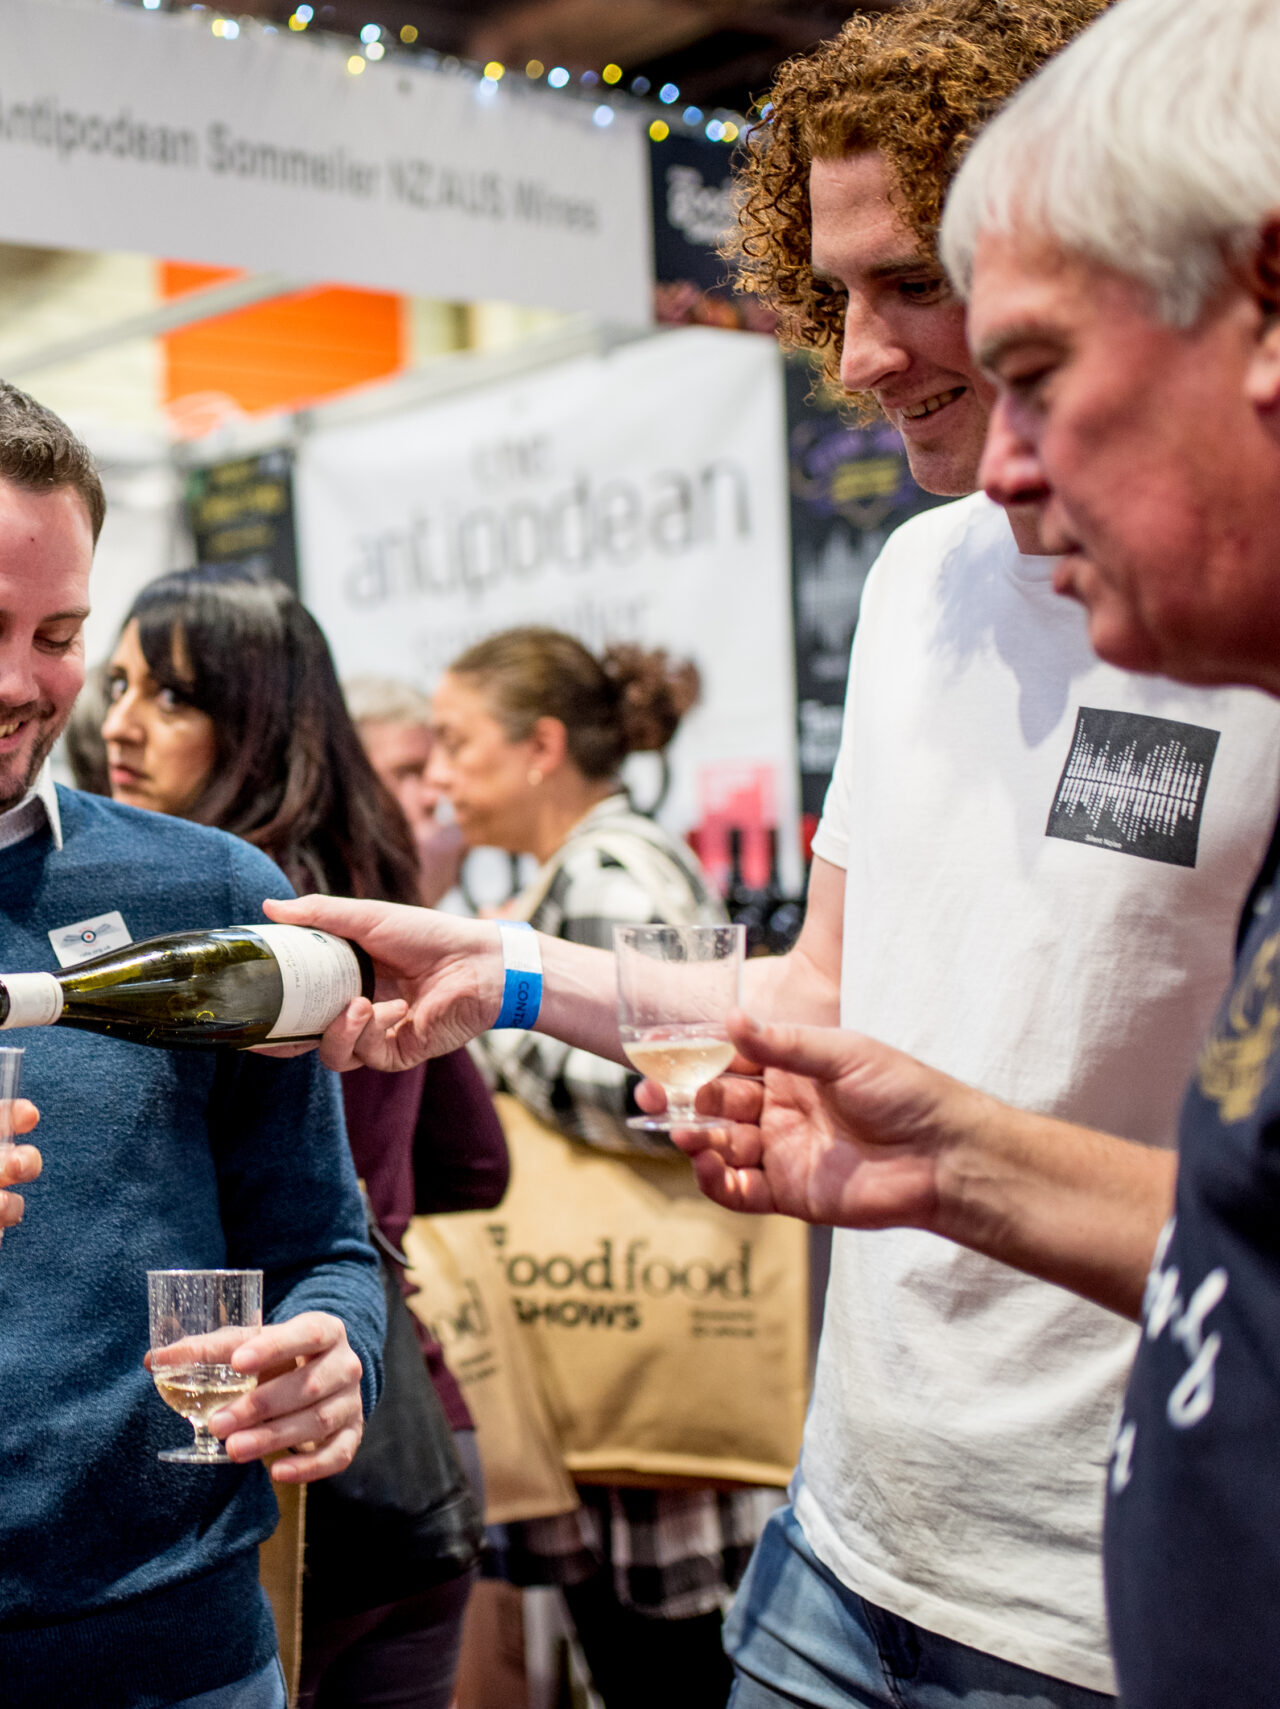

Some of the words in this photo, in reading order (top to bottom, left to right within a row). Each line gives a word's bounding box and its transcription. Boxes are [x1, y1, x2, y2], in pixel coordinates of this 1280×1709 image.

[206, 121, 381, 200] Sommelier
[513, 180, 601, 237] Wines
[345, 457, 753, 611] antipodean
